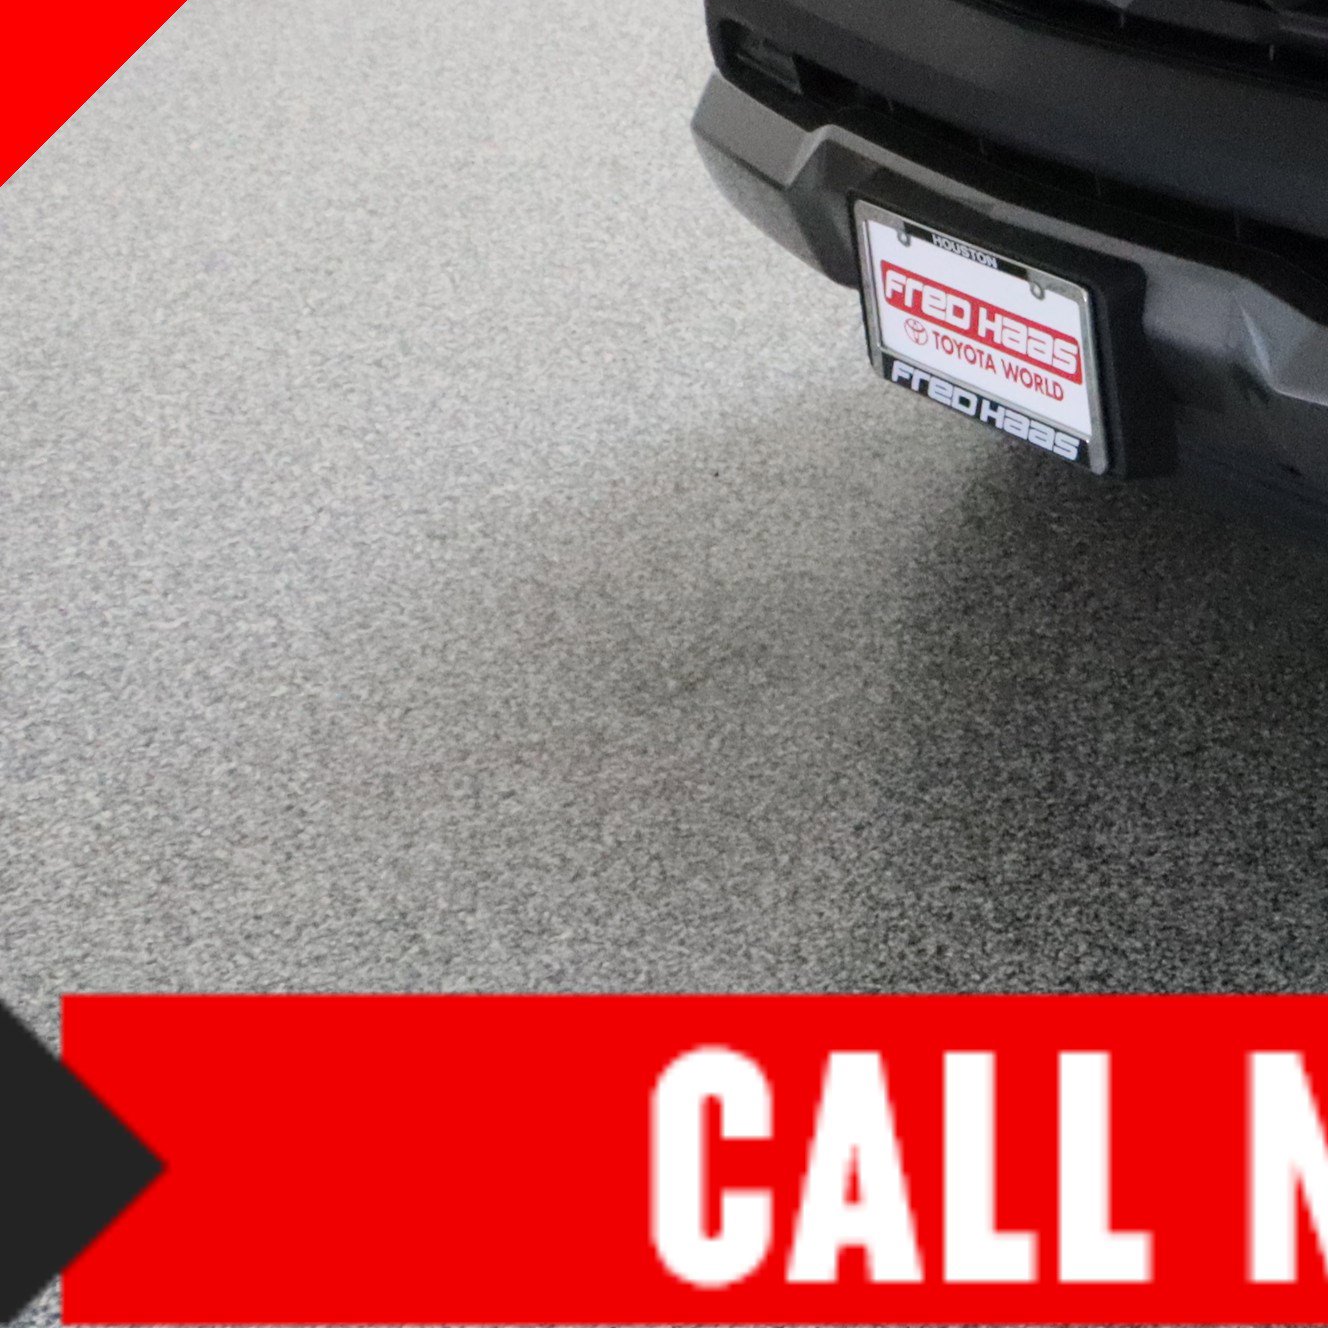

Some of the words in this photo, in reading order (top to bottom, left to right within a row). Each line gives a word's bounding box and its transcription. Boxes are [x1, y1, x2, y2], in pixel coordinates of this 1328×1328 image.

[931, 233, 999, 269] HOUSTON
[932, 330, 997, 372] TOYOTA
[1001, 358, 1065, 402] WORLD
